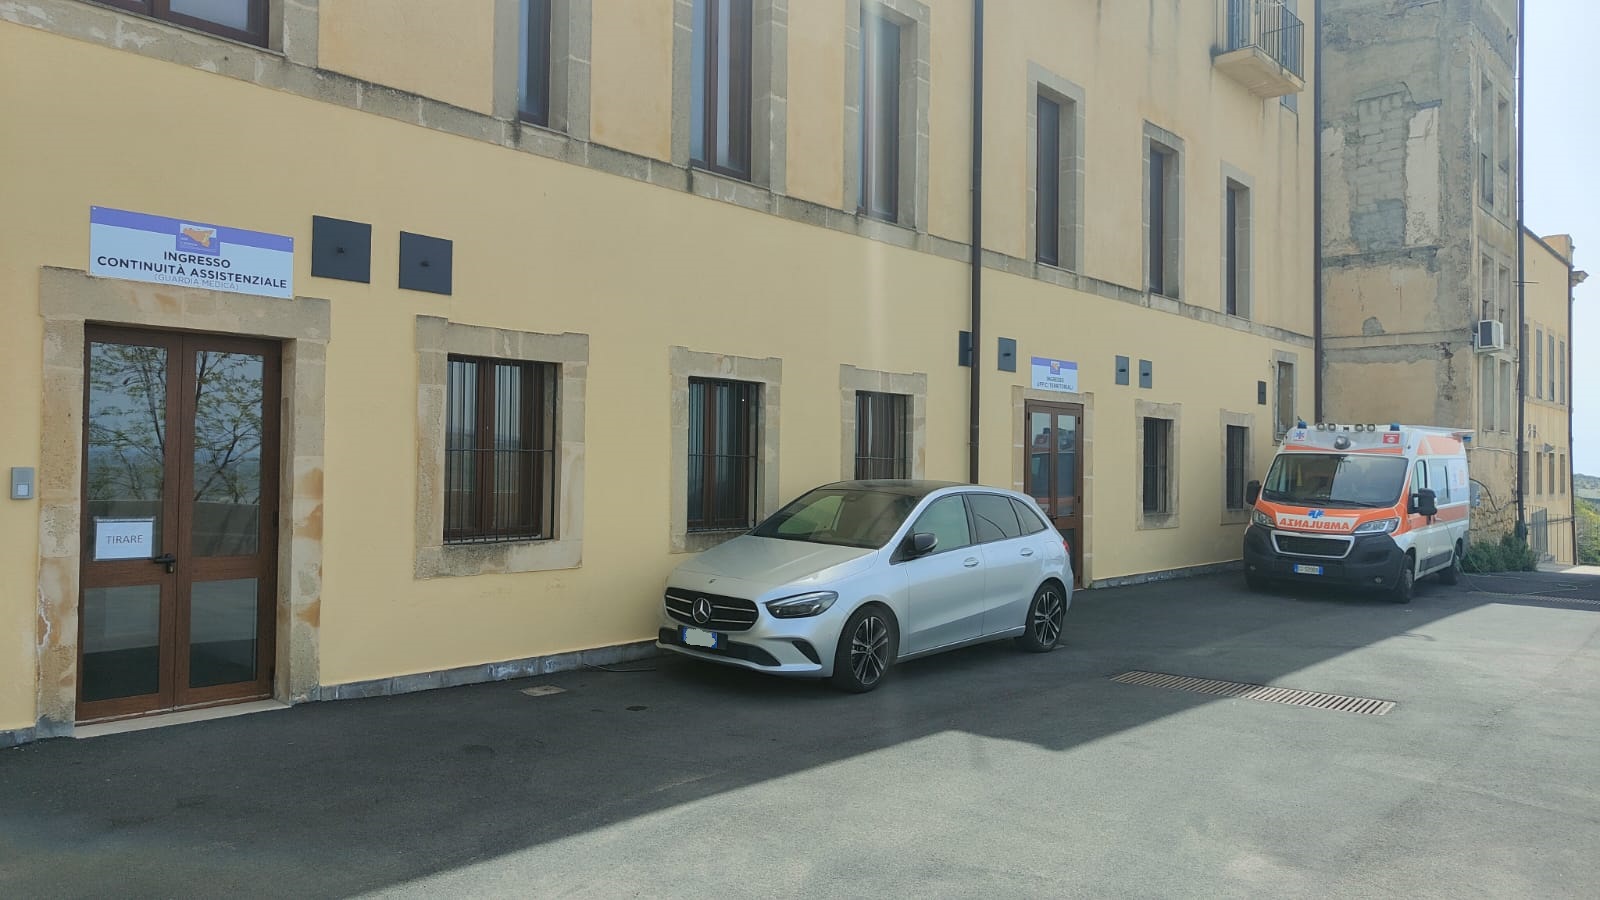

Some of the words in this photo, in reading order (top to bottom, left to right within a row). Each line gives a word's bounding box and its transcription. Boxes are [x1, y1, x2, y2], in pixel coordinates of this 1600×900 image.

[164, 251, 231, 269] INGRESSO
[97, 256, 186, 276] CONTINUITÀ
[190, 268, 287, 288] ASSISTENZIALE
[154, 274, 200, 286] (GUARDIA
[201, 278, 239, 291] MEDICA)
[105, 534, 144, 545] TIRARE
